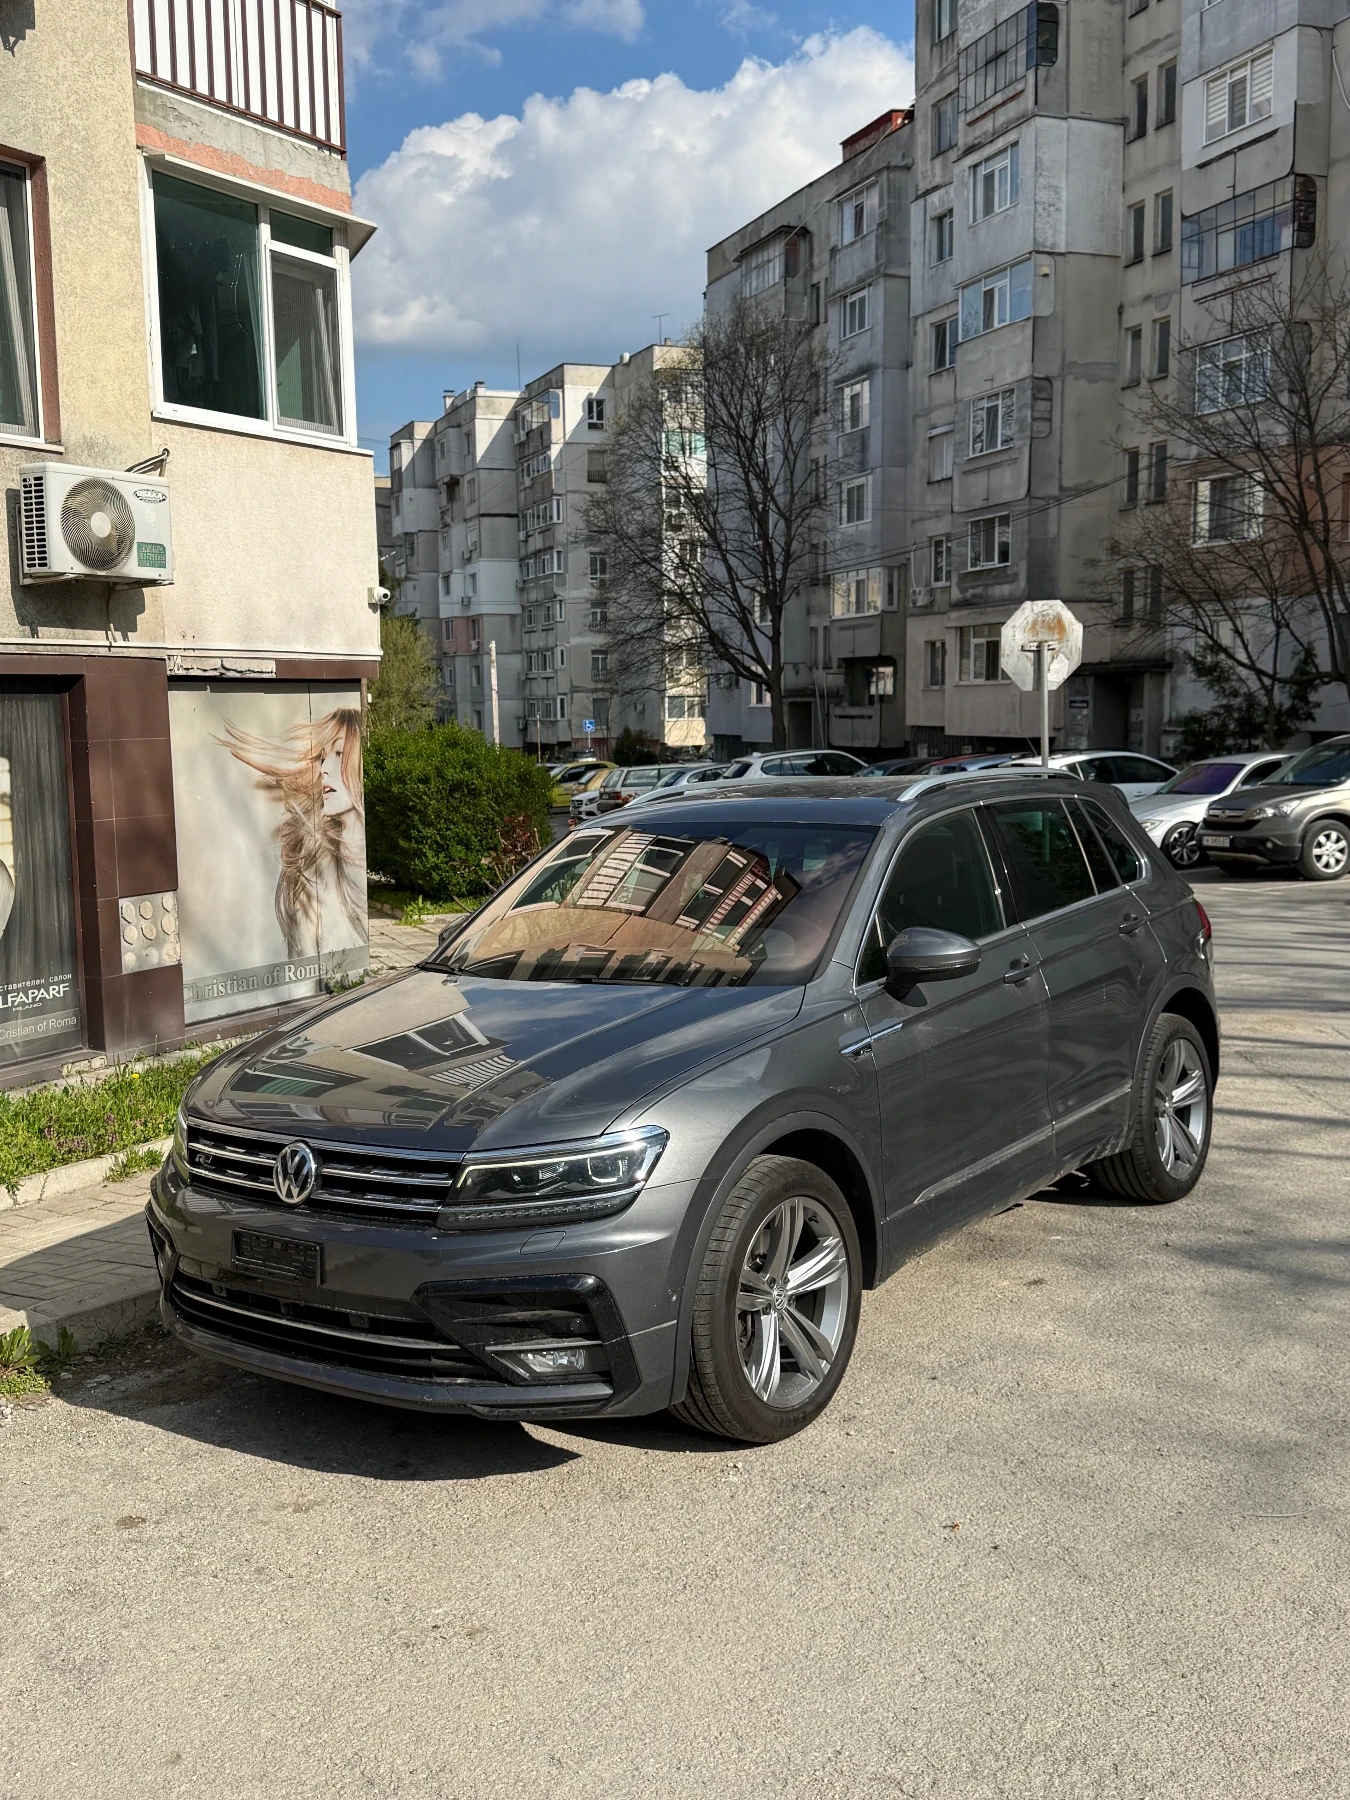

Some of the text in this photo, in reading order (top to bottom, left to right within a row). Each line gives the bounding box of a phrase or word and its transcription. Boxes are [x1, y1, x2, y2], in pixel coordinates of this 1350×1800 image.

[49, 973, 72, 982] салон
[182, 961, 327, 1004] Christian of Roma
[0, 1016, 77, 1040] Cristian of Roma
